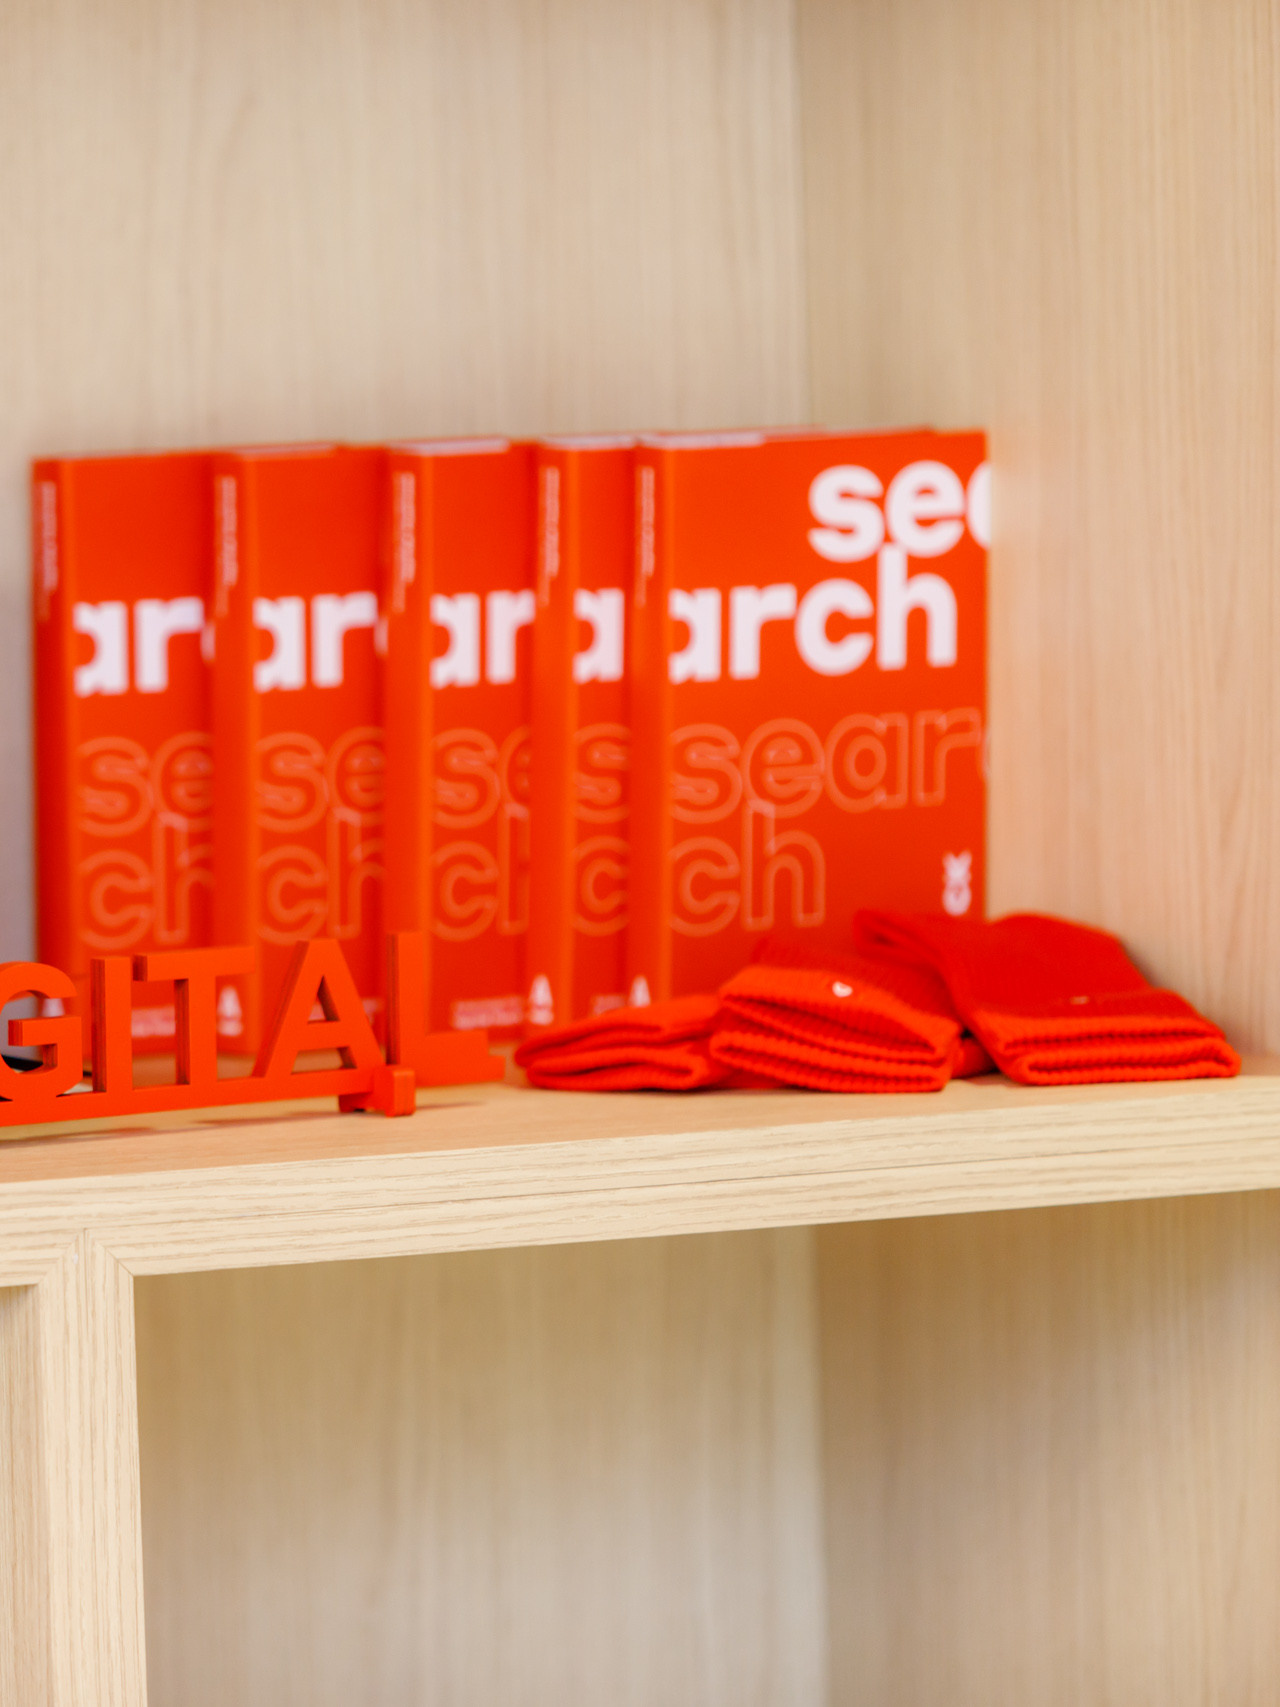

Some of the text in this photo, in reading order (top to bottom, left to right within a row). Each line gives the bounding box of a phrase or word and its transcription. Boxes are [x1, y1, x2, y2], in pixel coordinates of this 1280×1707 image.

[668, 541, 958, 685] arch
[668, 706, 988, 825] sear
[668, 800, 826, 938] ch
